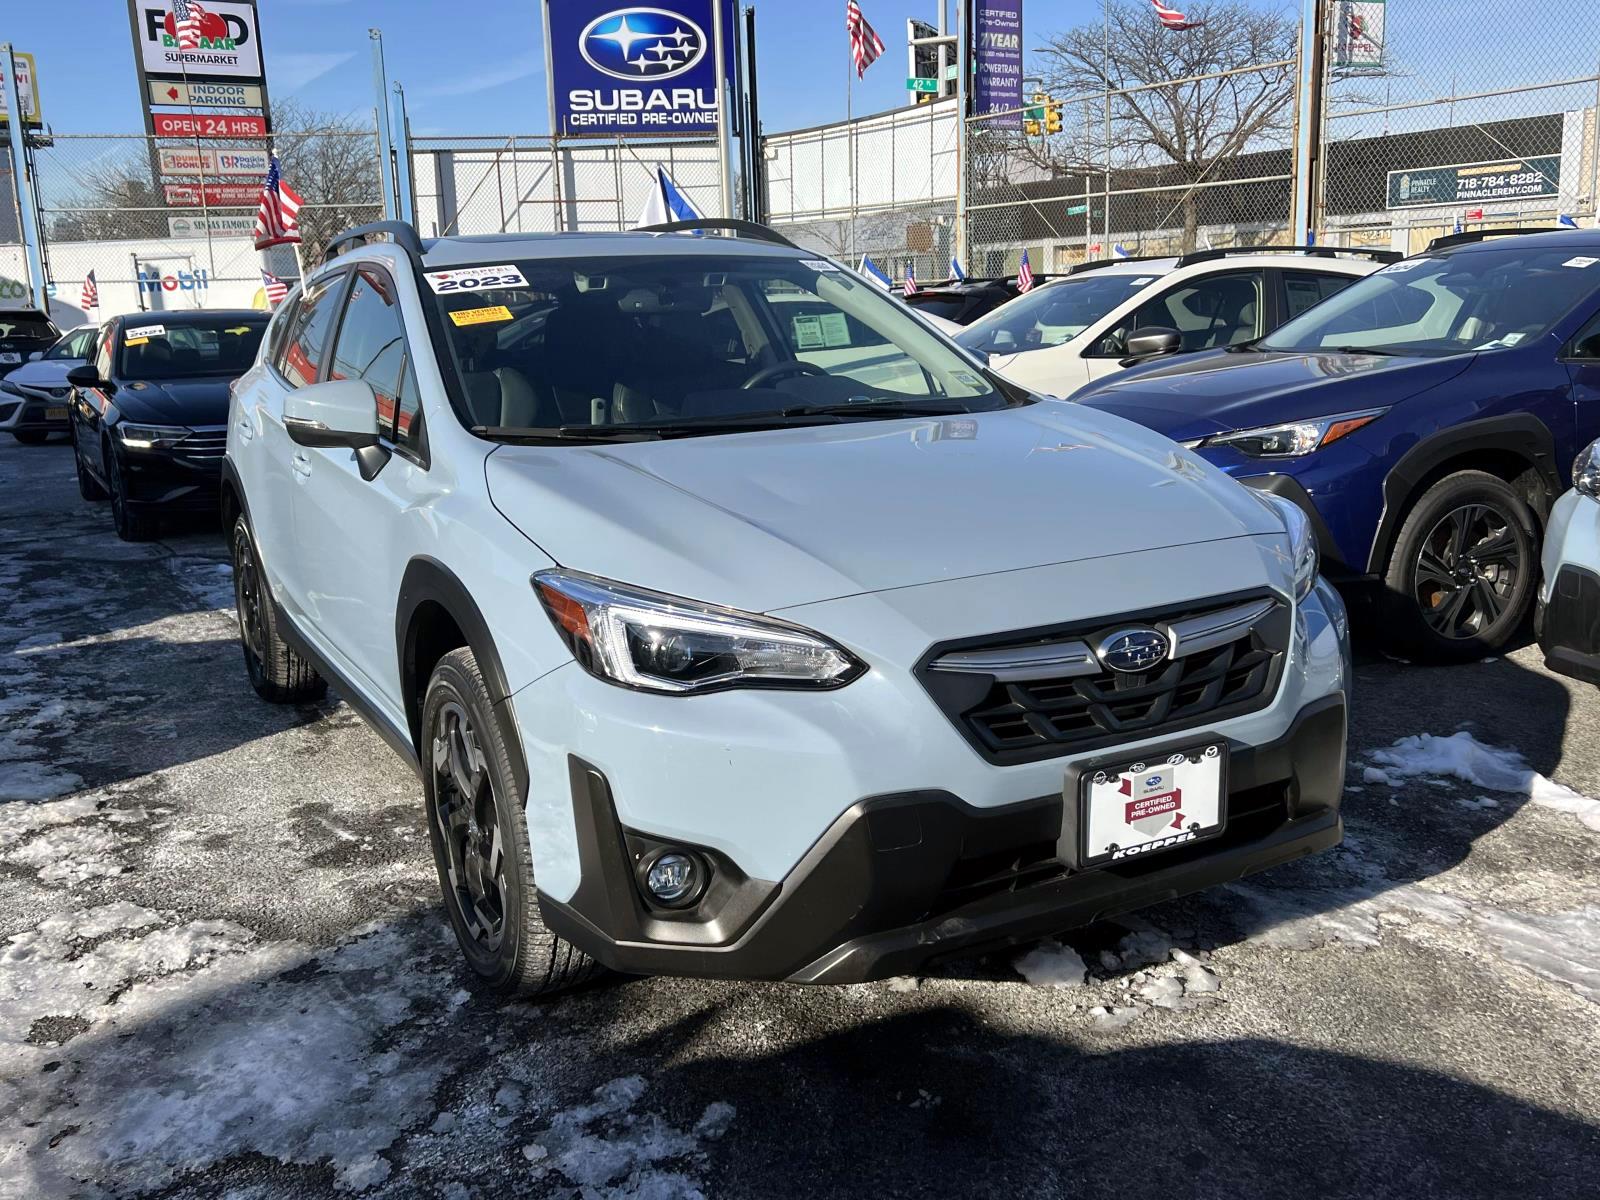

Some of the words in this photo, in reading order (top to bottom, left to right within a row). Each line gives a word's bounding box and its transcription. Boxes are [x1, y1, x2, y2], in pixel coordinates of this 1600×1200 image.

[980, 10, 1017, 18] CERTIFIED
[145, 9, 249, 46] FOD
[980, 18, 1018, 27] Pre-Owned
[163, 34, 236, 50] BAAR
[990, 33, 1018, 48] YEAR
[165, 52, 238, 65] SUPERMARKET
[980, 63, 1019, 74] POWERTRAIN
[912, 80, 923, 89] 42
[982, 77, 1017, 87] WARRANTY
[193, 86, 244, 95] INDOOR
[189, 95, 246, 105] PARKING
[569, 88, 718, 111] SUBARU
[570, 112, 637, 125] CERTIFIED
[642, 112, 718, 124] PRE-OWNED
[162, 120, 201, 132] OPEN
[206, 120, 228, 134] 24
[232, 122, 258, 133] HRS
[1411, 178, 1437, 187] PINNACLE
[1457, 172, 1543, 189] 718-784-8282
[1410, 186, 1430, 194] REALTY
[1457, 185, 1542, 199] PINNACLERENY.COM
[222, 220, 249, 229] FAMOUS
[454, 267, 513, 276] KOEPPEL
[139, 269, 208, 292] Mobil
[437, 275, 522, 291] 2023
[1134, 795, 1173, 810] CERTIFIED
[1131, 802, 1176, 818] PRE-OWNED
[1112, 832, 1197, 859] KOEPPEL
